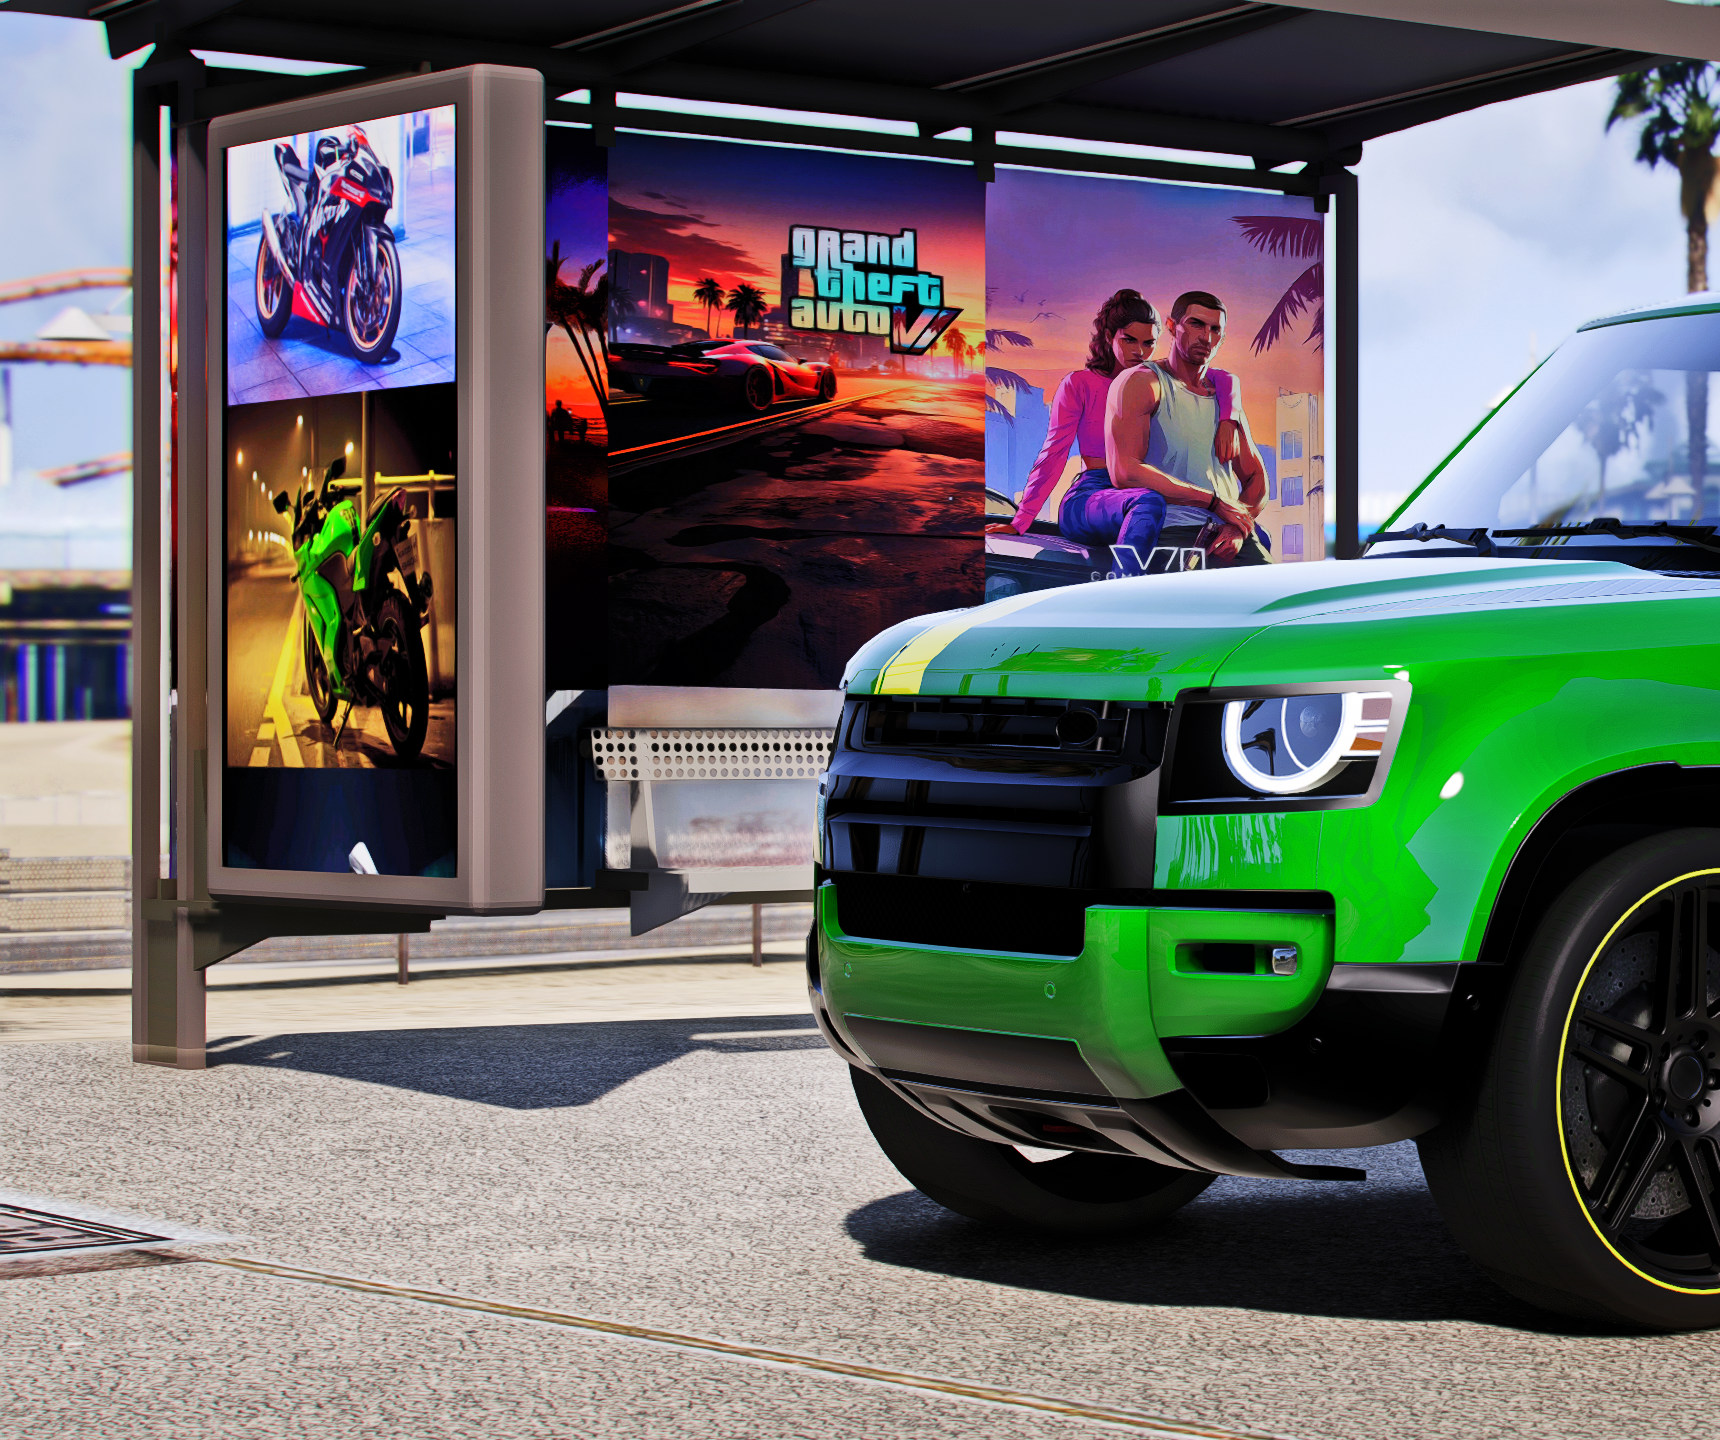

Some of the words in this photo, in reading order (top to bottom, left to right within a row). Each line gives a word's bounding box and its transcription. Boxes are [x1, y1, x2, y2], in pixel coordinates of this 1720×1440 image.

[791, 226, 914, 269] grand
[814, 262, 941, 307] theft
[791, 298, 891, 335] auto
[892, 304, 962, 355] VI
